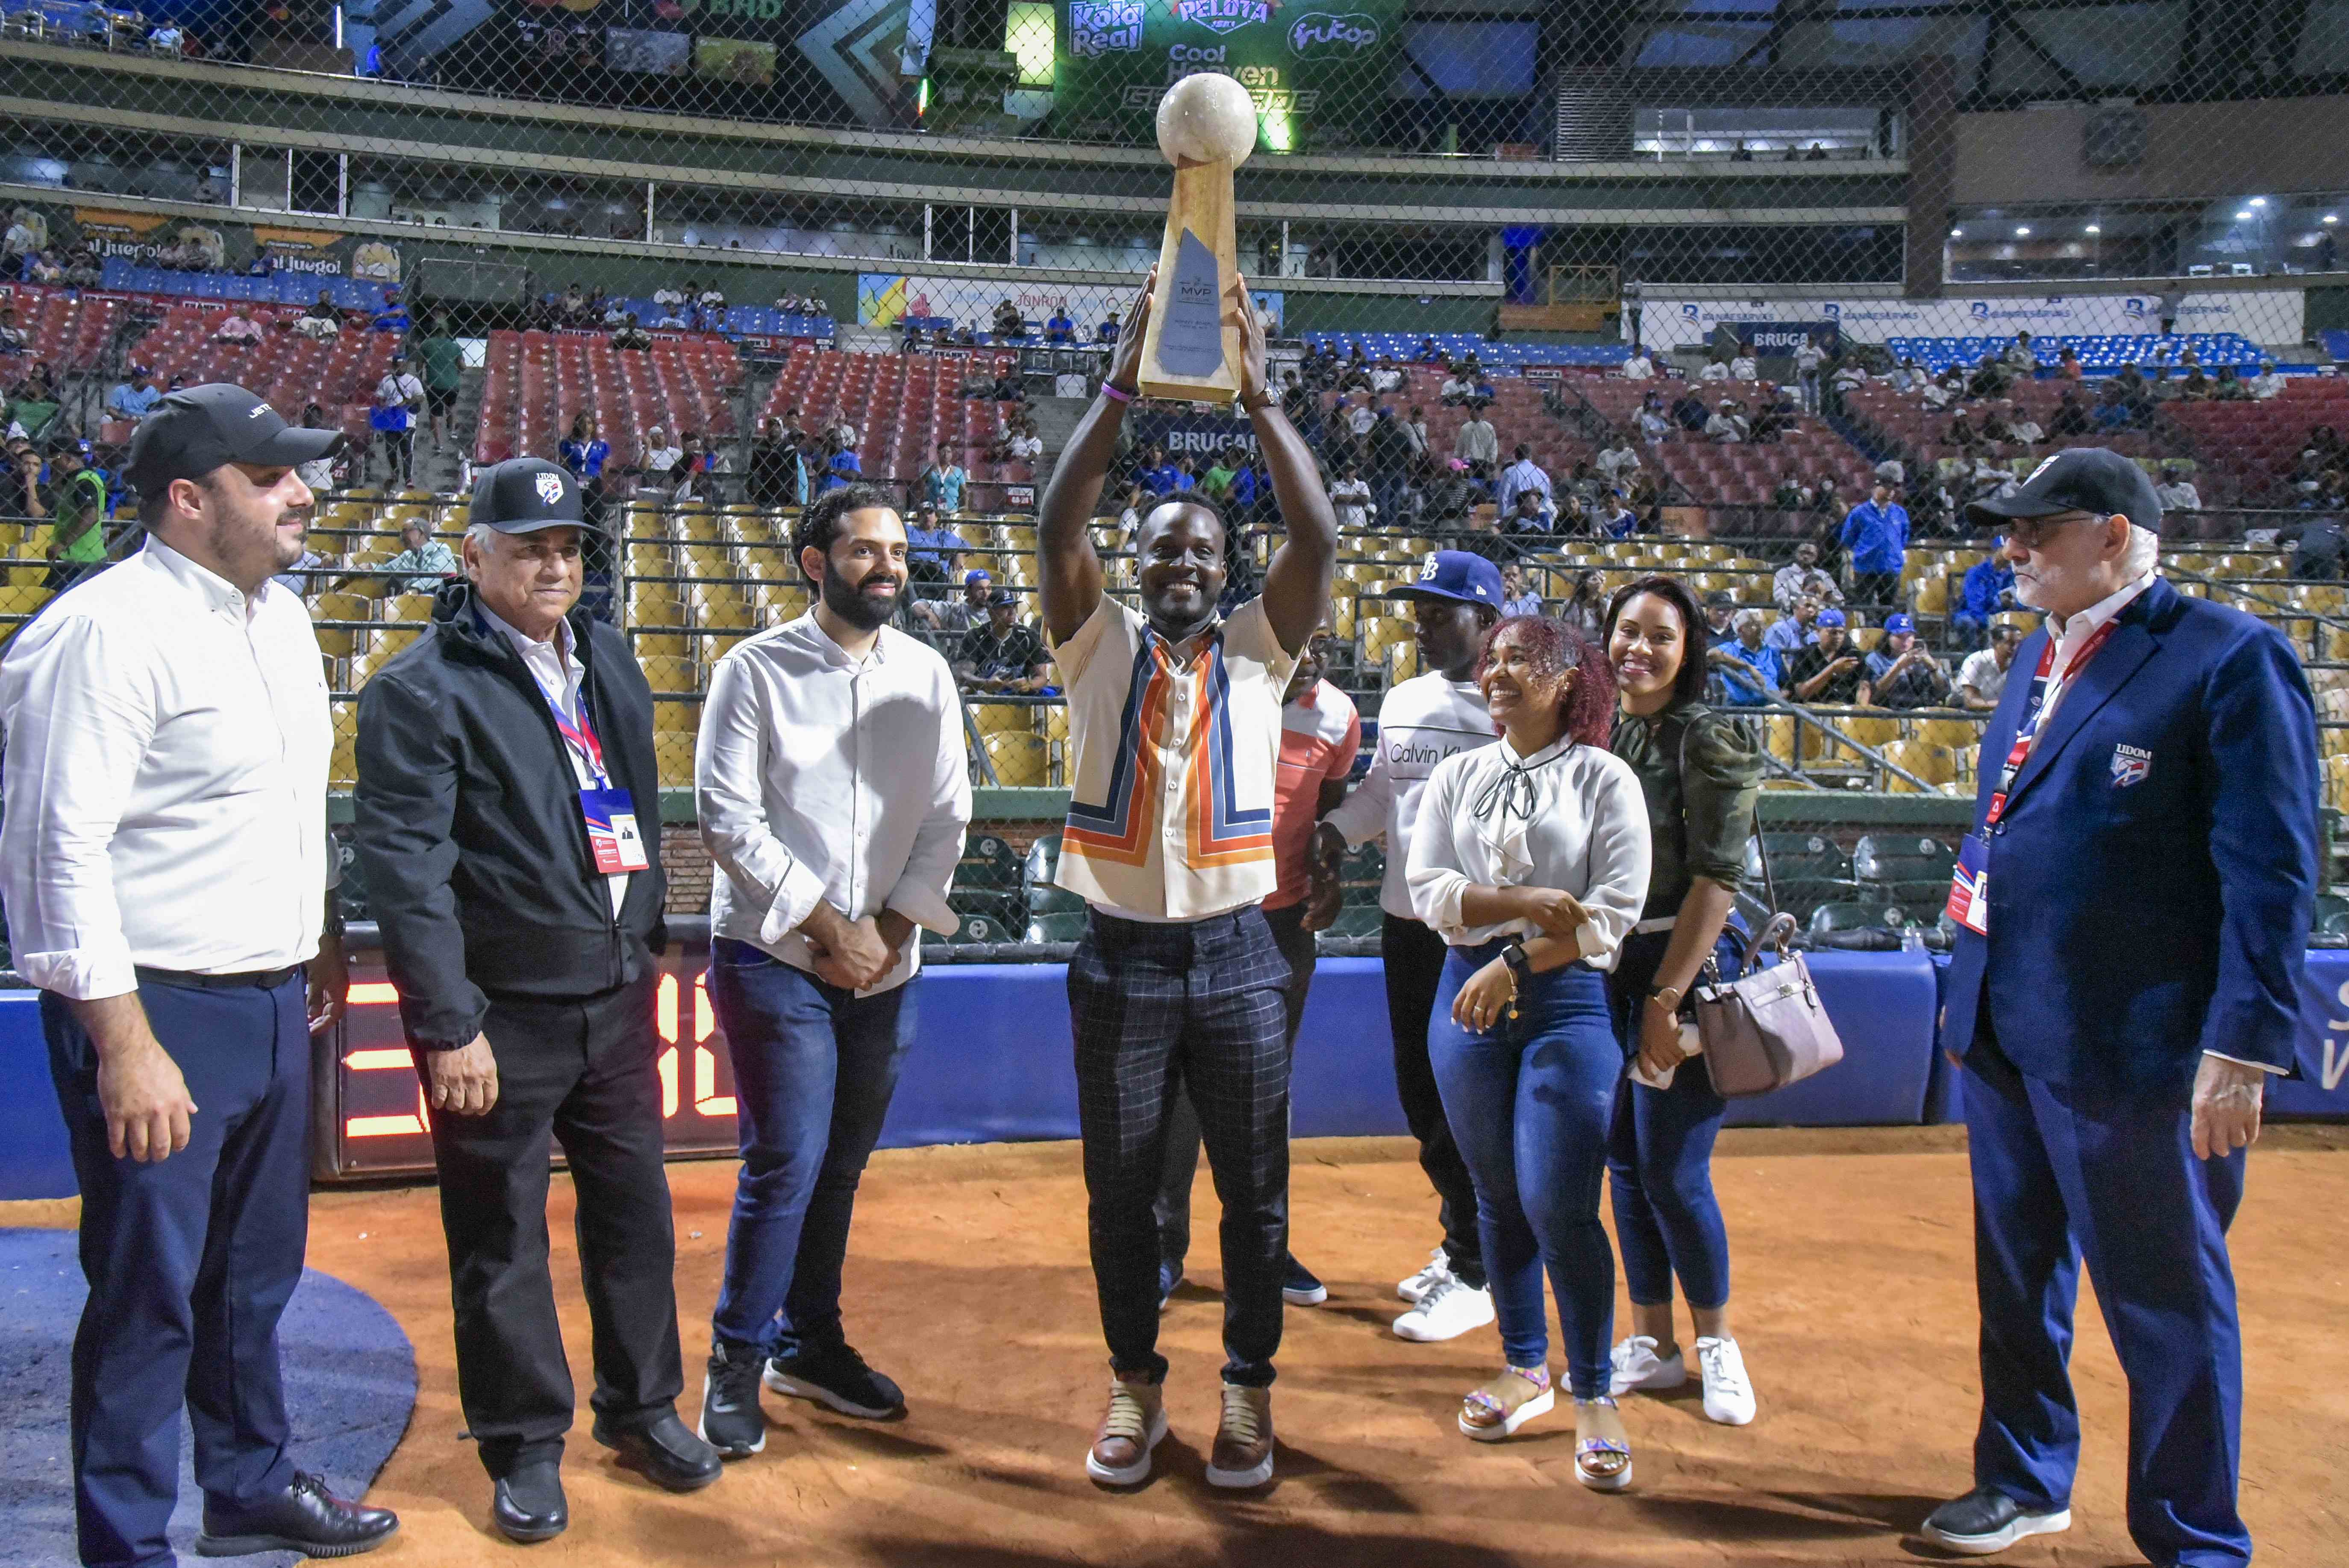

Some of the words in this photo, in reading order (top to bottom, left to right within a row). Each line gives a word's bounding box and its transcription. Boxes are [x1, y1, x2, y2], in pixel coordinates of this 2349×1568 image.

[1073, 1, 1140, 32] Kola
[1179, 0, 1267, 23] PELOTA
[1073, 26, 1138, 55] Real
[1170, 44, 1226, 62] Cool
[285, 255, 341, 276] juego!
[1015, 293, 1067, 308] JONRÓN
[1181, 287, 1211, 296] MVP
[1168, 431, 1257, 453] BRUGAL
[536, 472, 559, 481] LIDOM
[1390, 742, 1438, 764] Calvin
[2116, 743, 2152, 760] LIDOM
